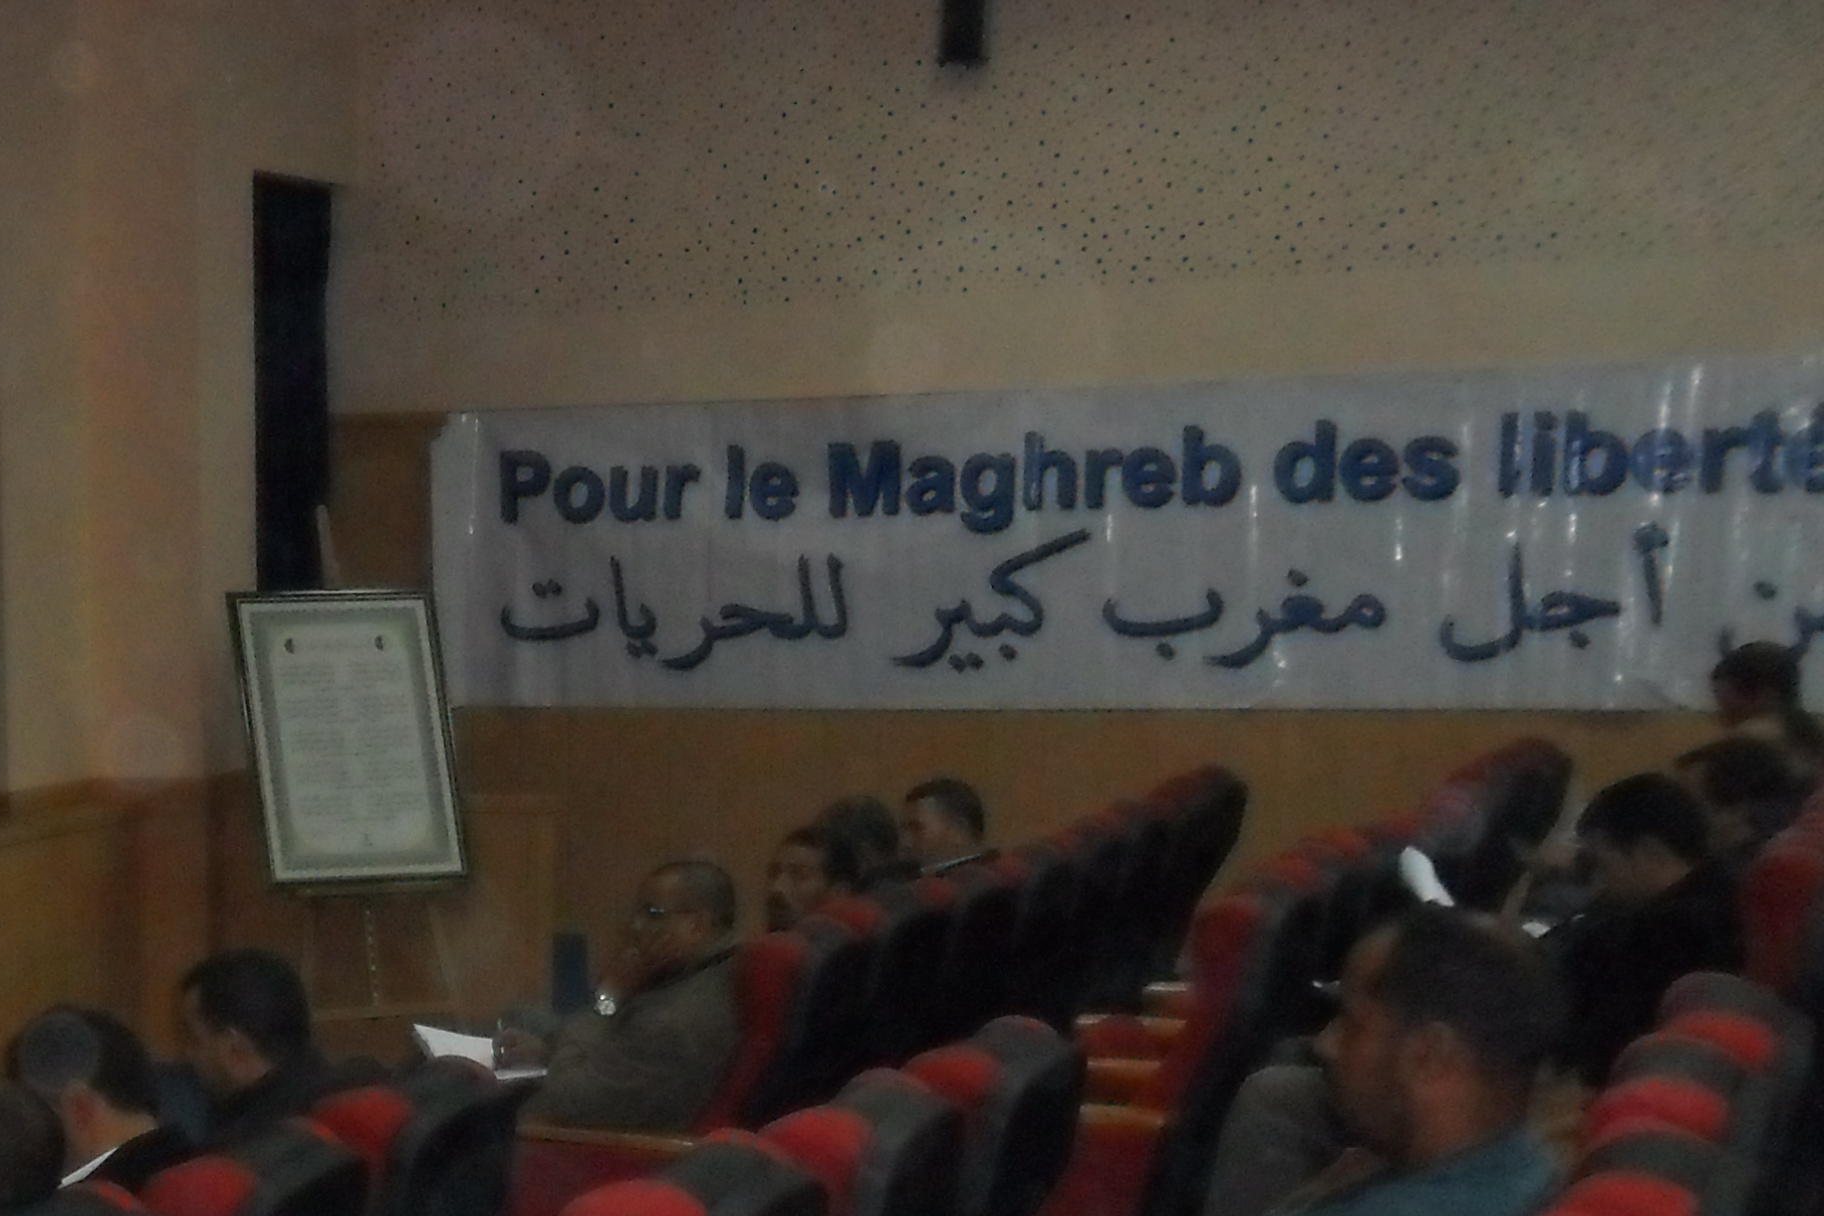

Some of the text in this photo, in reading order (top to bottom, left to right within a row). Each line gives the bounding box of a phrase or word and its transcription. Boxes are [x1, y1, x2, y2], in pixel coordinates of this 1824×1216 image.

[499, 448, 702, 525] Pour
[724, 443, 800, 522] le
[827, 423, 1242, 534] Maghreb
[1273, 418, 1461, 504] des
[499, 552, 848, 671] للحريات
[890, 526, 1092, 672] كبير
[1102, 567, 1387, 669] مغرب
[1440, 520, 1670, 664] أجل
